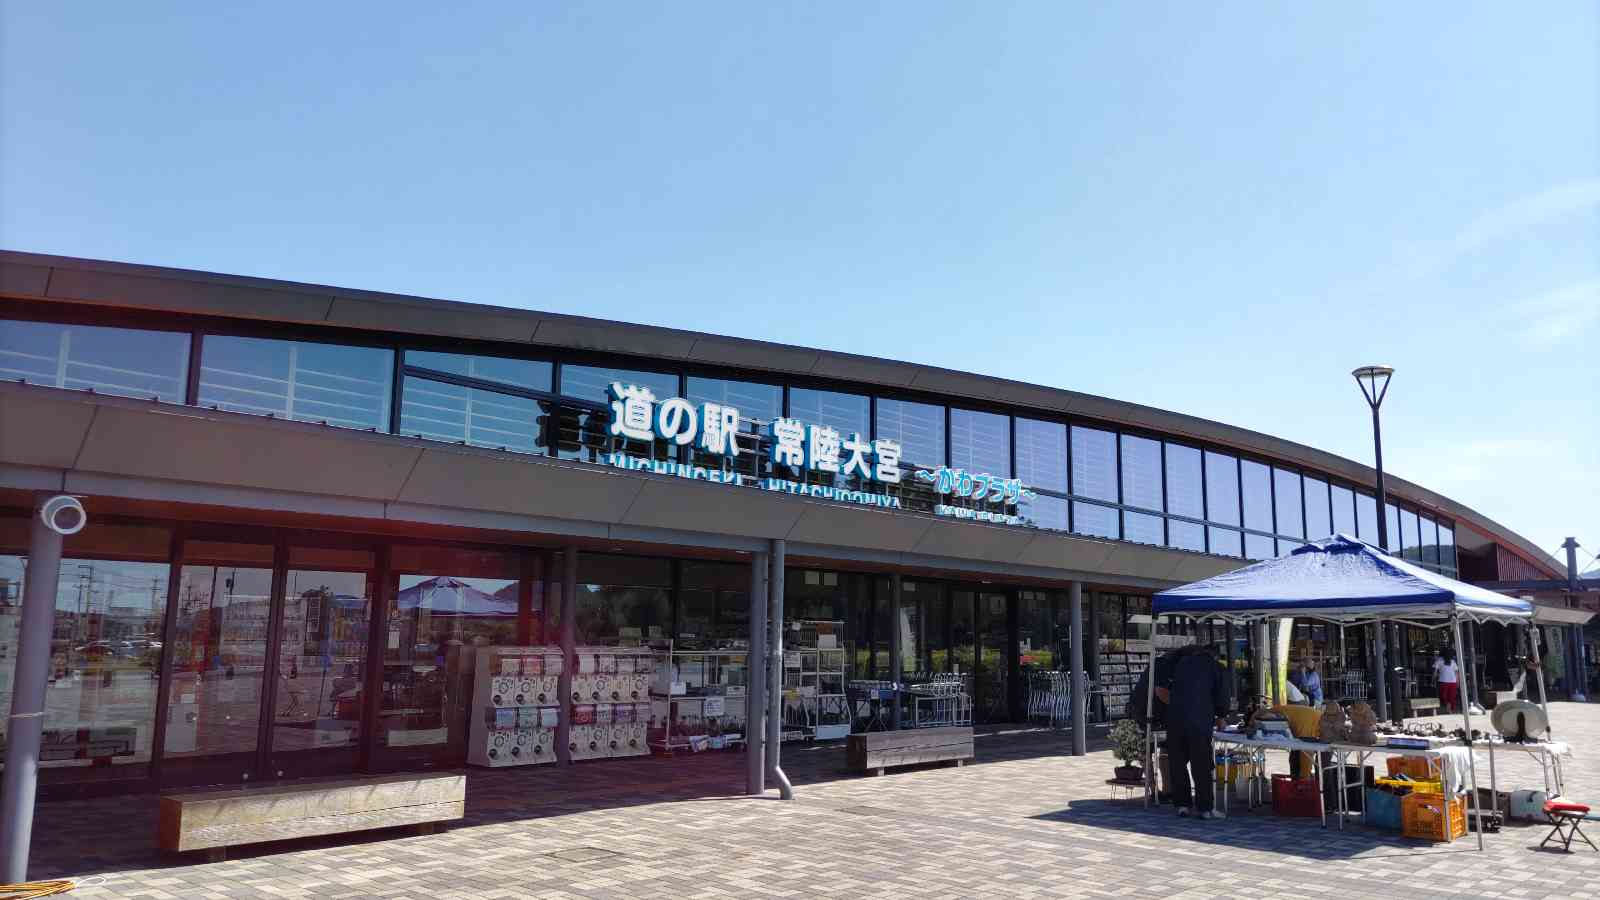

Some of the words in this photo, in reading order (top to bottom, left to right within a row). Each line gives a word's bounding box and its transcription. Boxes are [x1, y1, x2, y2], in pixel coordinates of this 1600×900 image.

[609, 381, 740, 456] 道の駅
[768, 416, 902, 485] 常陸大宮
